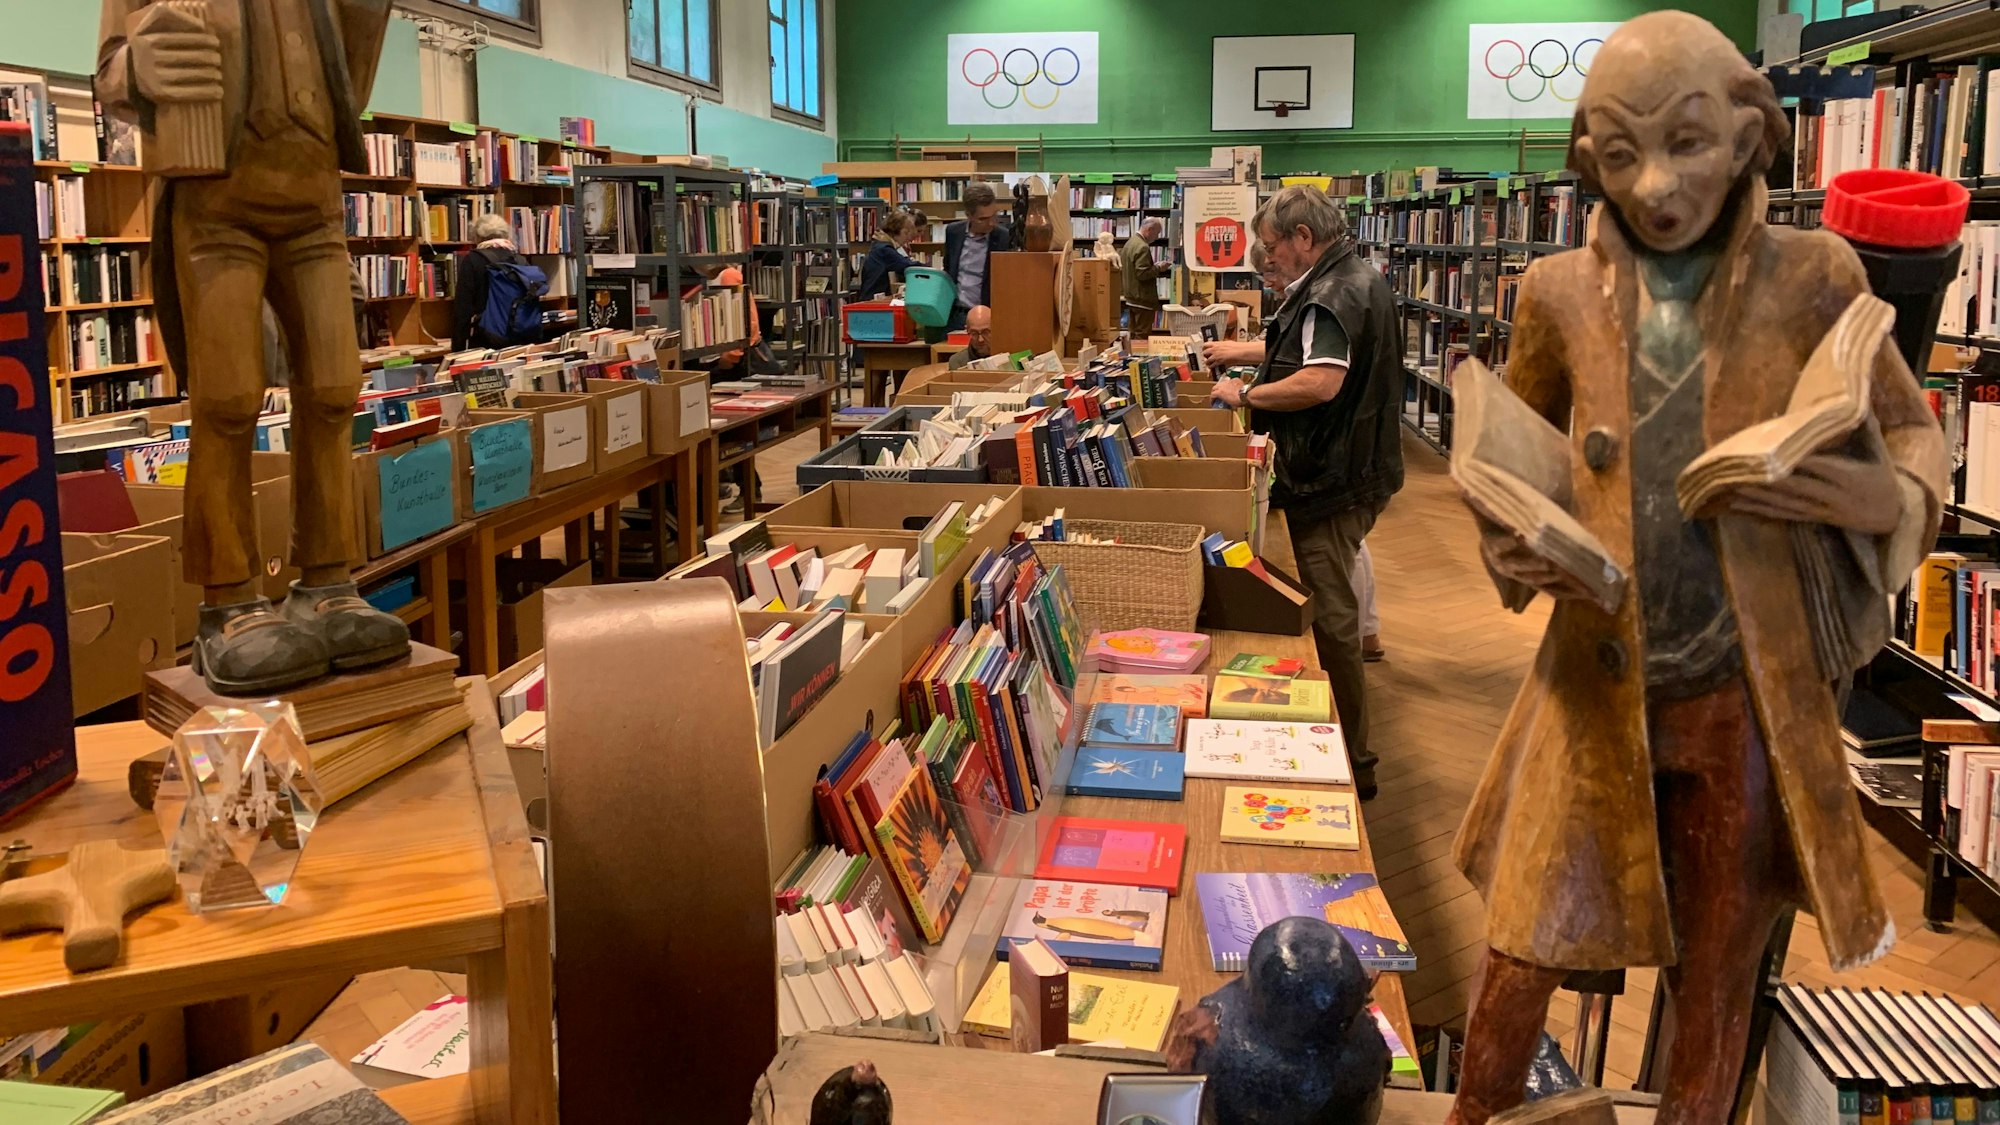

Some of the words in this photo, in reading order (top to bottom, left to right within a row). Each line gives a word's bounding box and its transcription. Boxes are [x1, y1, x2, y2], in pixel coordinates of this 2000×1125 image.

[1204, 225, 1237, 234] ABSTAND
[1204, 233, 1237, 242] HALTEN!
[1975, 385, 2000, 402] 18
[1023, 456, 1034, 485] PRAG
[1100, 473, 1109, 486] DER
[389, 469, 436, 494] Bundes-
[396, 485, 447, 512] Kunsthalle
[805, 661, 836, 698] KÖNNEN
[1024, 885, 1051, 910] Papa
[1060, 883, 1075, 896] der
